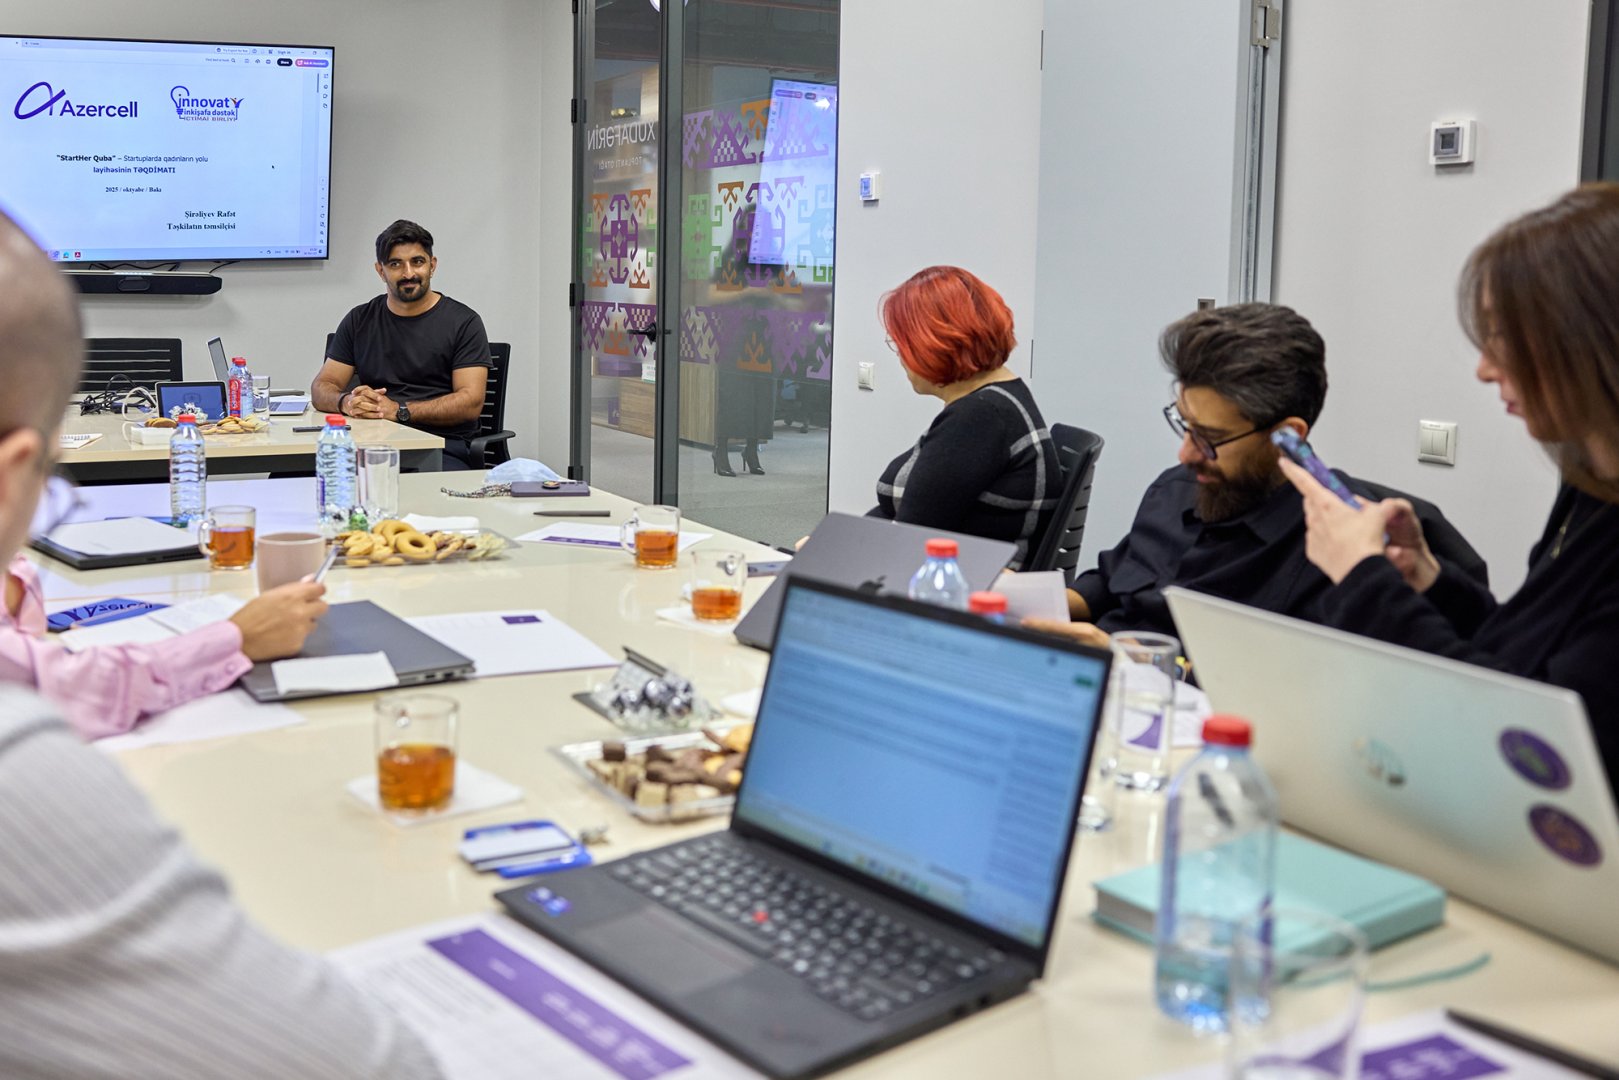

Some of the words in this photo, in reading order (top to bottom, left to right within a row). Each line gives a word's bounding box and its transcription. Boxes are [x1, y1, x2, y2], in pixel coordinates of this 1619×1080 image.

[59, 99, 138, 118] Azercell
[212, 108, 236, 116] dəstək
[123, 154, 162, 163] Startuplarda
[195, 155, 209, 164] yolu
[133, 165, 176, 174] TƏQDİMATI
[184, 210, 216, 219] Şirəliyev
[217, 210, 236, 218] Rafət
